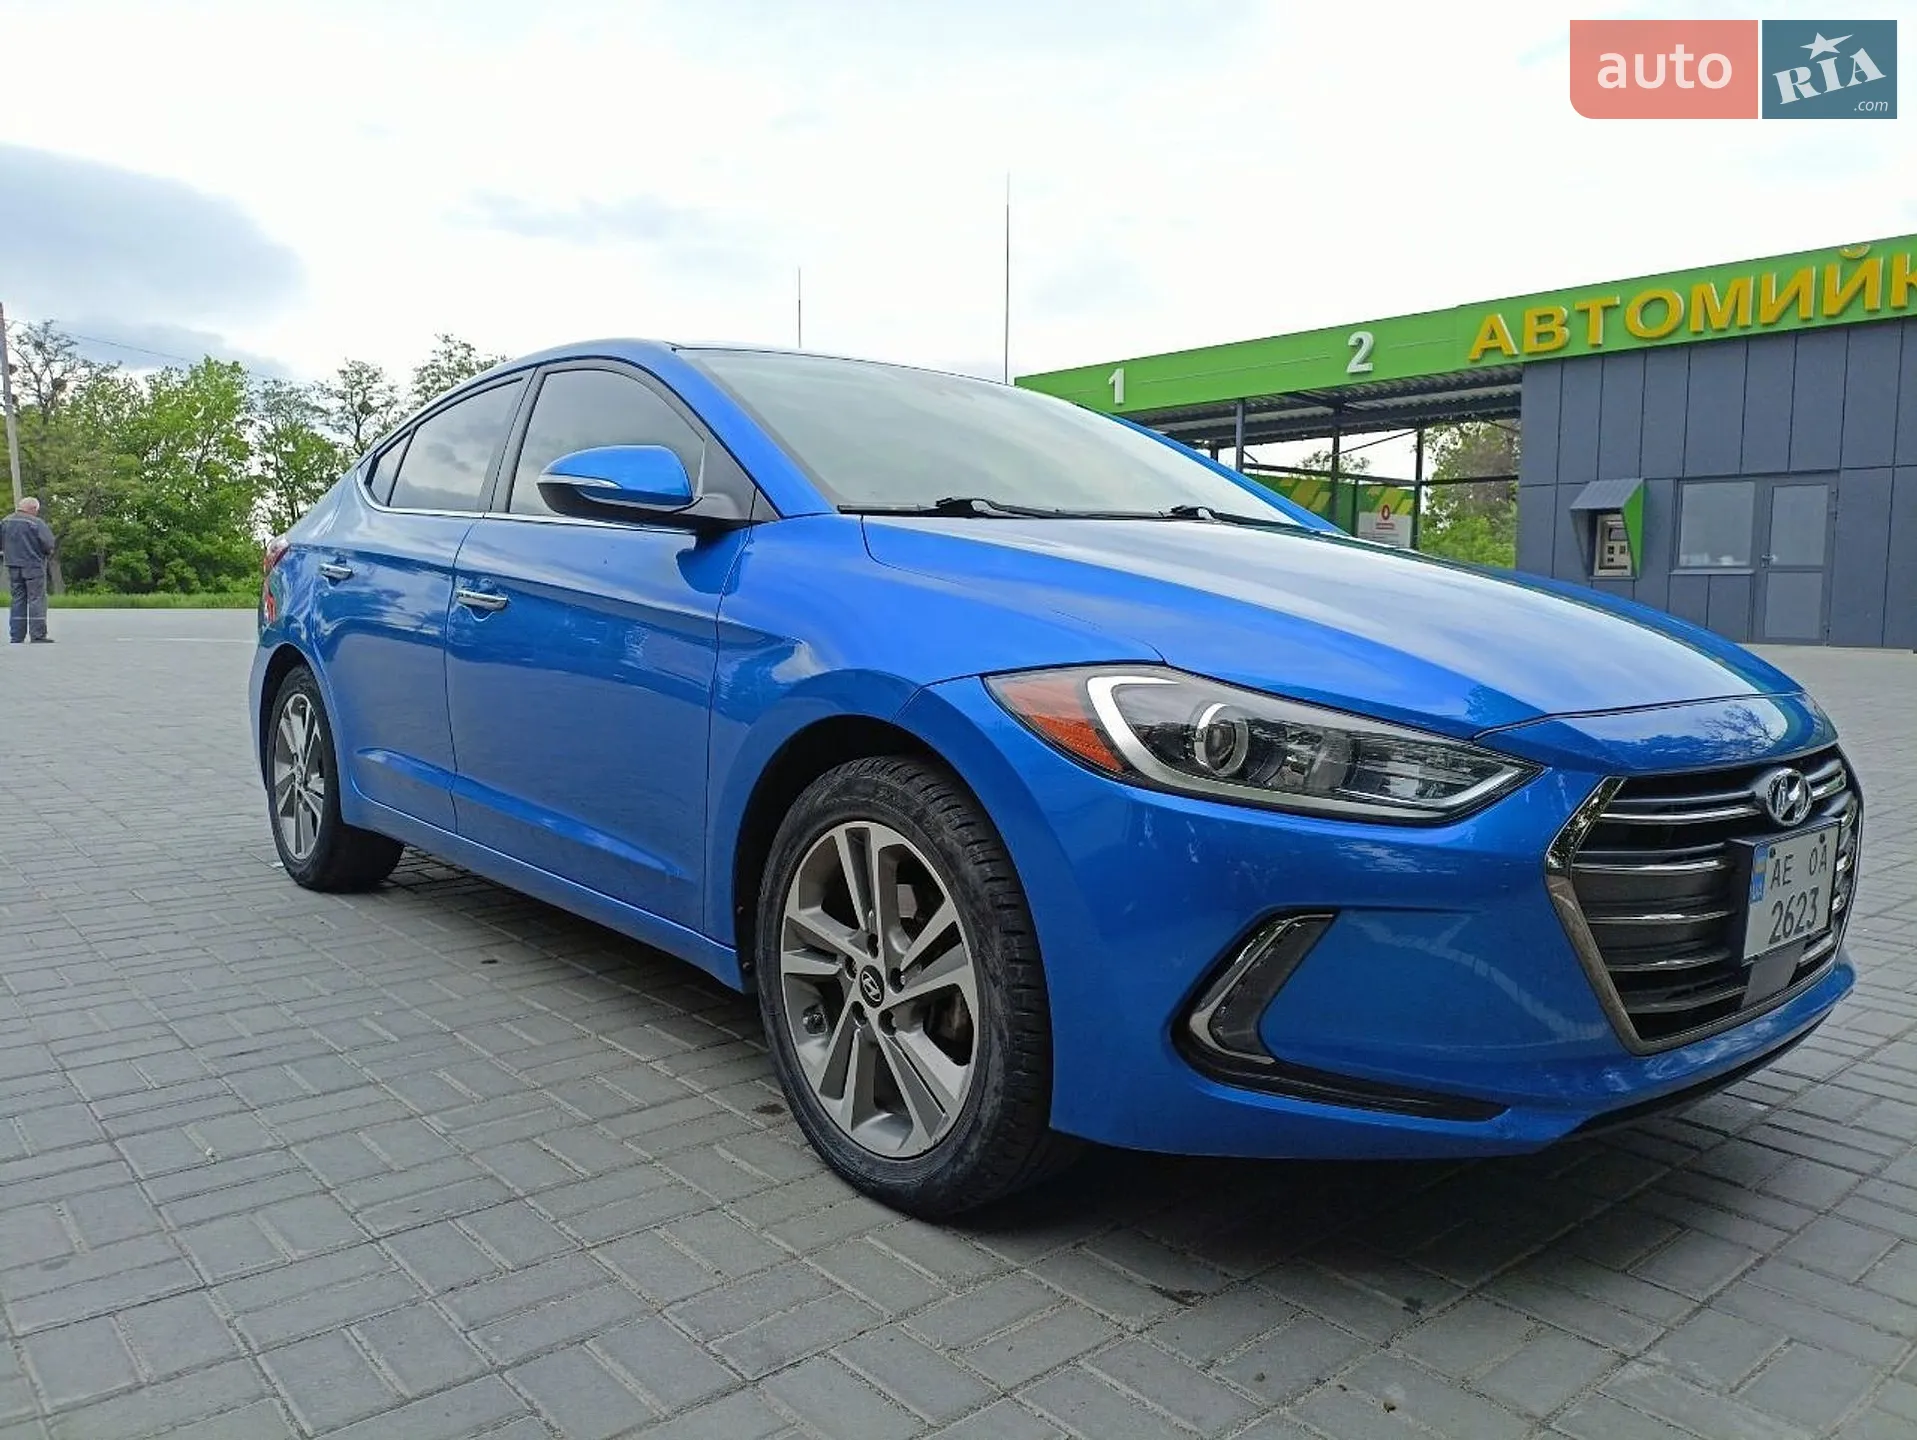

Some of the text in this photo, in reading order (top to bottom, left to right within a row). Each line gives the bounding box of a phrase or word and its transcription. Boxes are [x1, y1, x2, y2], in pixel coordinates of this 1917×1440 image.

[1346, 331, 1374, 373] 2
[1108, 368, 1125, 404] 1
[1771, 854, 1794, 889] AE
[1769, 887, 1819, 944] 2623
